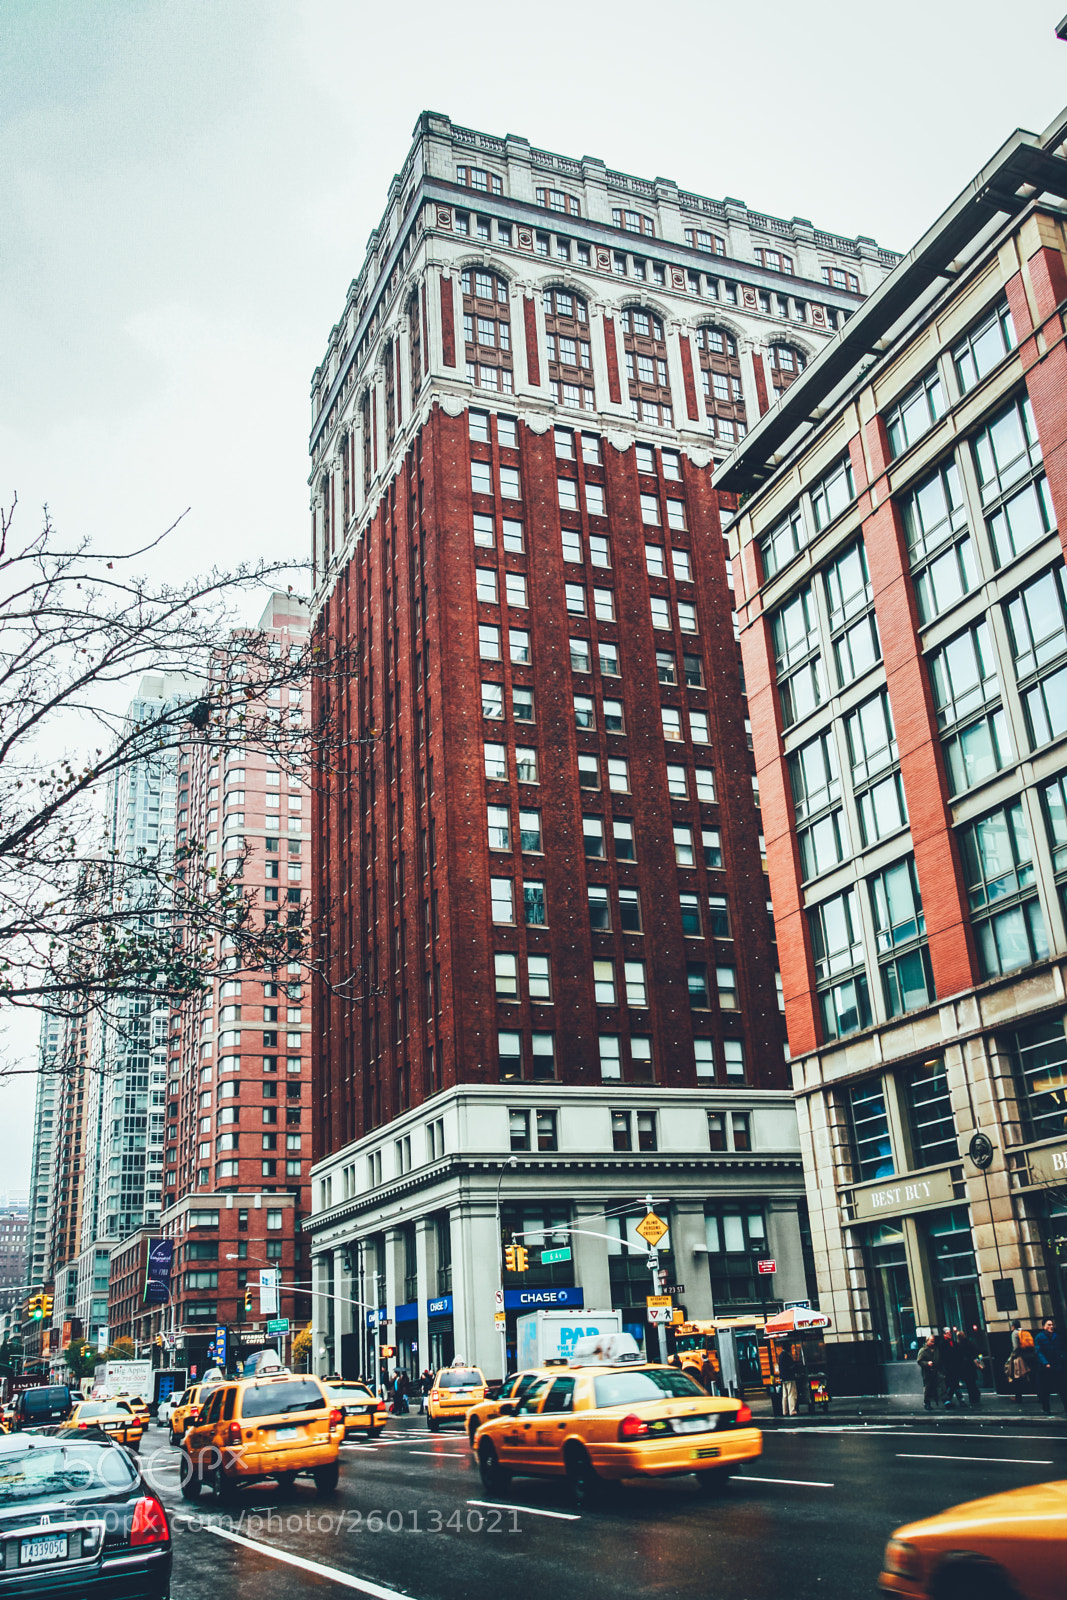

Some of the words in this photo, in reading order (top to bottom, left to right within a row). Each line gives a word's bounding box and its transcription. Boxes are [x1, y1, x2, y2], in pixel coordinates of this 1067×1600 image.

[871, 1189, 900, 1208] BEST
[904, 1181, 931, 1201] BUY
[520, 1292, 557, 1303] CHASE
[430, 1300, 444, 1312] CHASE
[216, 1329, 226, 1365] Park
[114, 1367, 126, 1375] Big
[128, 1367, 147, 1375] Apple
[24, 1540, 64, 1558] T433905C
